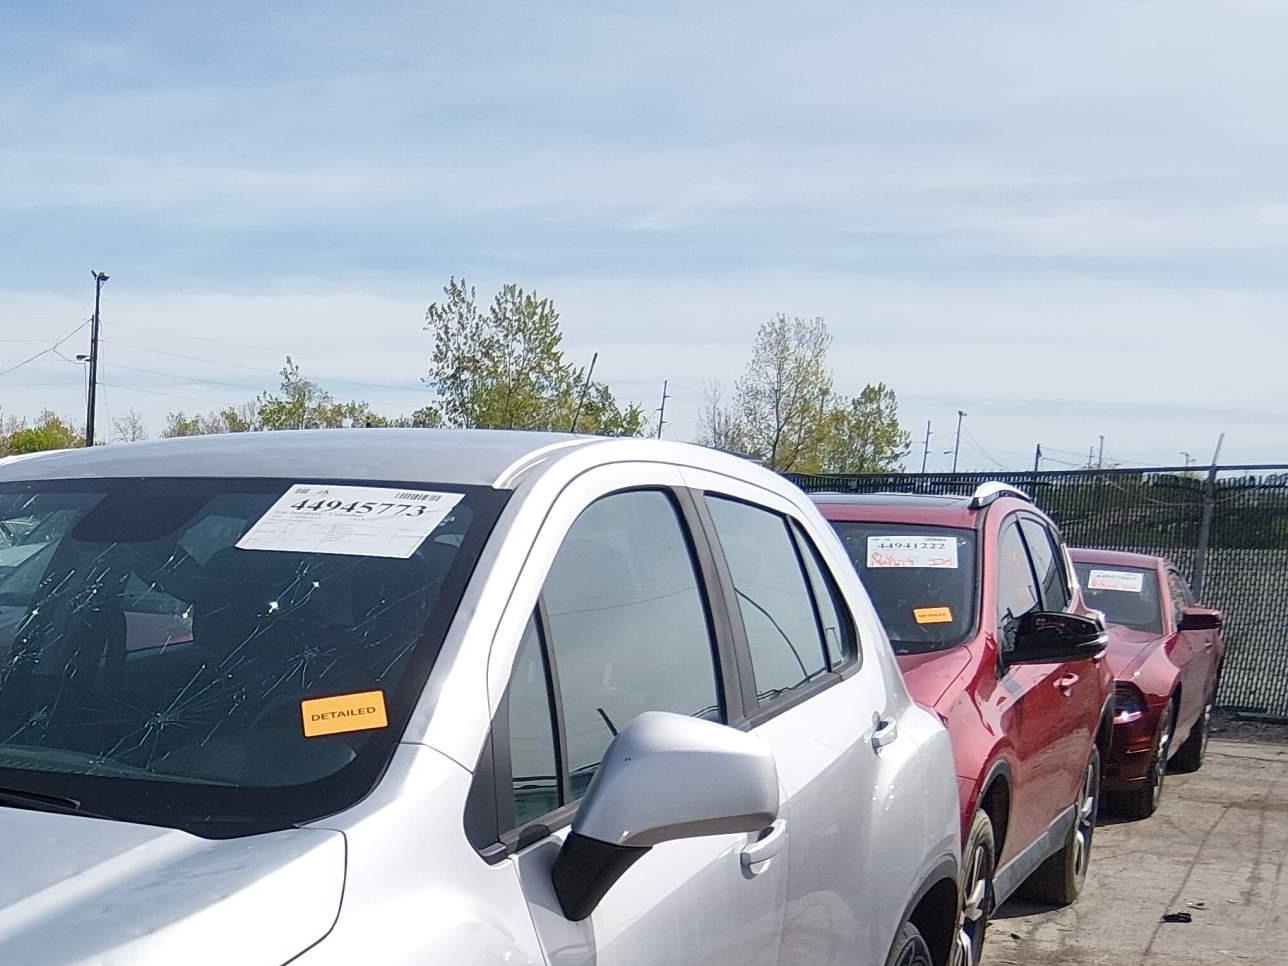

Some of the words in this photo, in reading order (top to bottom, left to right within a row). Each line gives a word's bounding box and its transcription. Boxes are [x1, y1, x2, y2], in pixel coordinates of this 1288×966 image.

[290, 498, 427, 517] 44945773
[878, 542, 946, 550] 44941222
[311, 706, 376, 722] DETAILED
